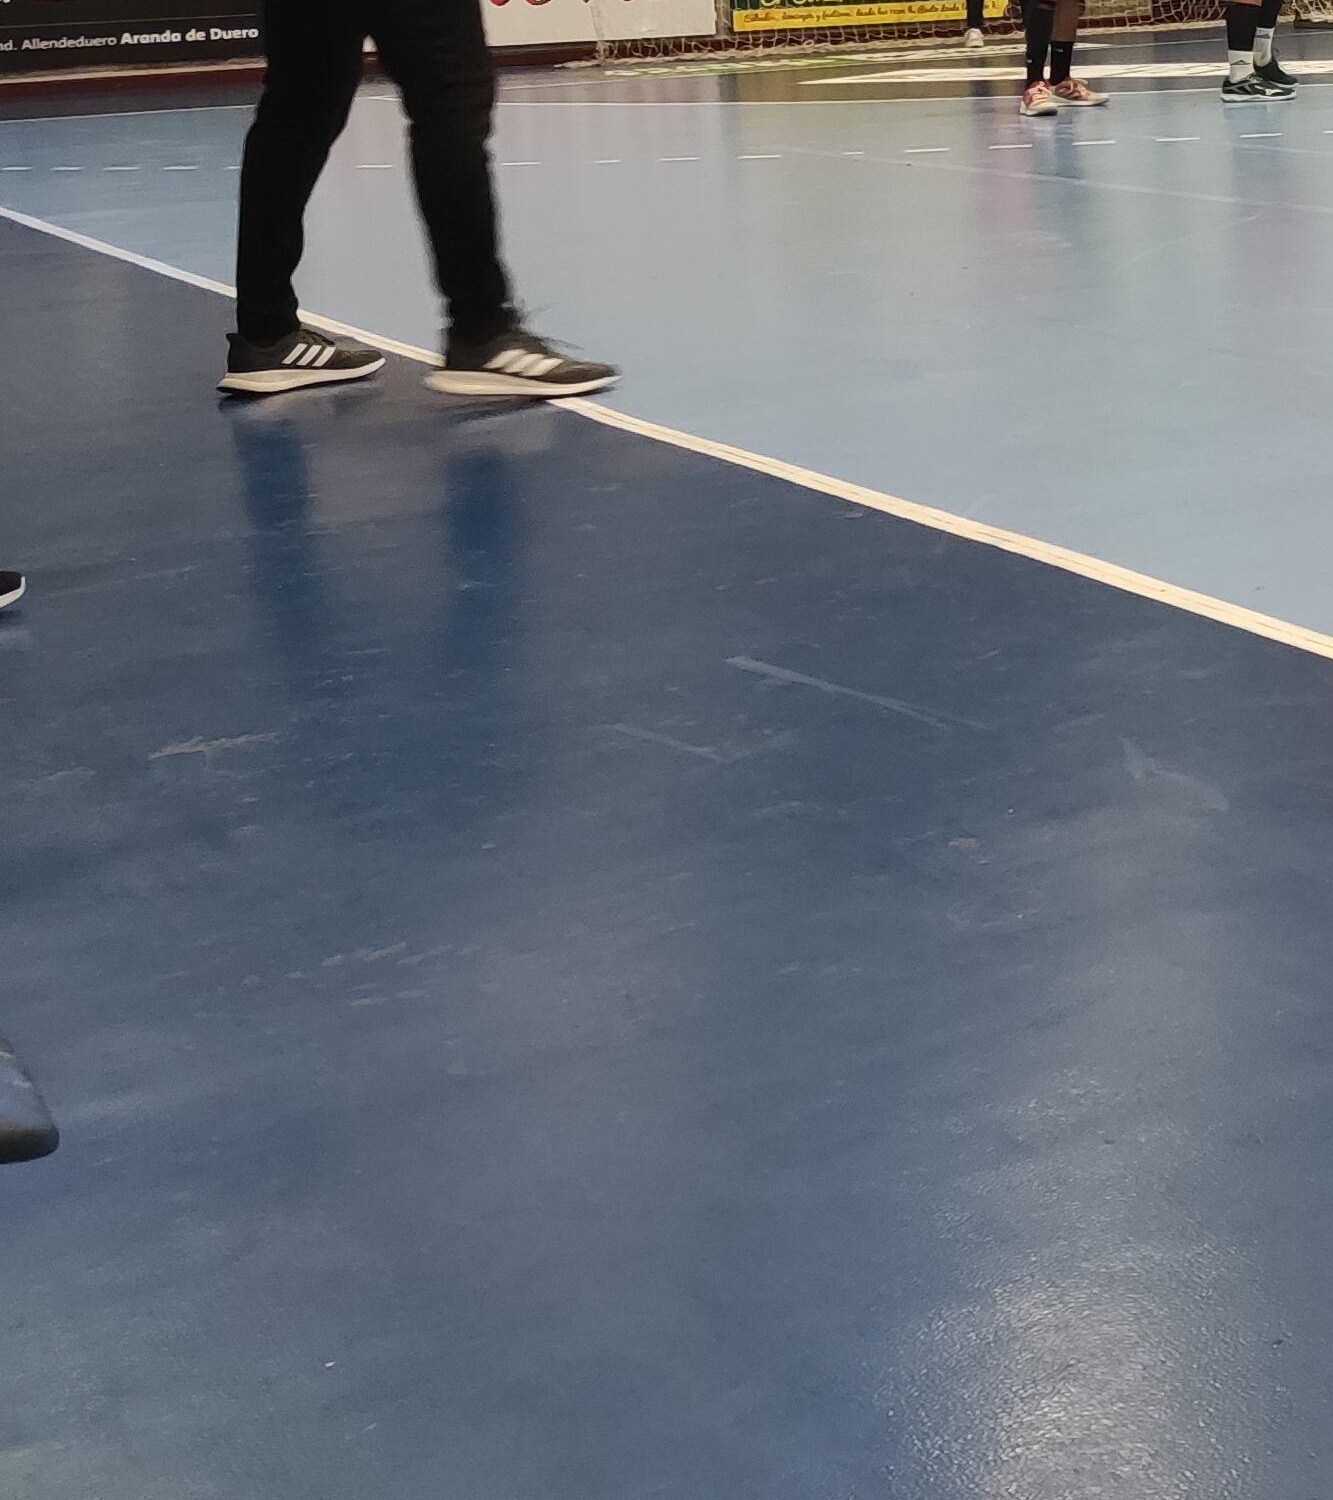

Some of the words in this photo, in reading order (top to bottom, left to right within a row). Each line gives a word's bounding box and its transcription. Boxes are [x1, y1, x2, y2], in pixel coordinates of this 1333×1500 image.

[22, 35, 117, 51] Allendeduero
[121, 29, 182, 46] Aranda
[185, 28, 206, 42] de
[210, 27, 260, 41] Duero
